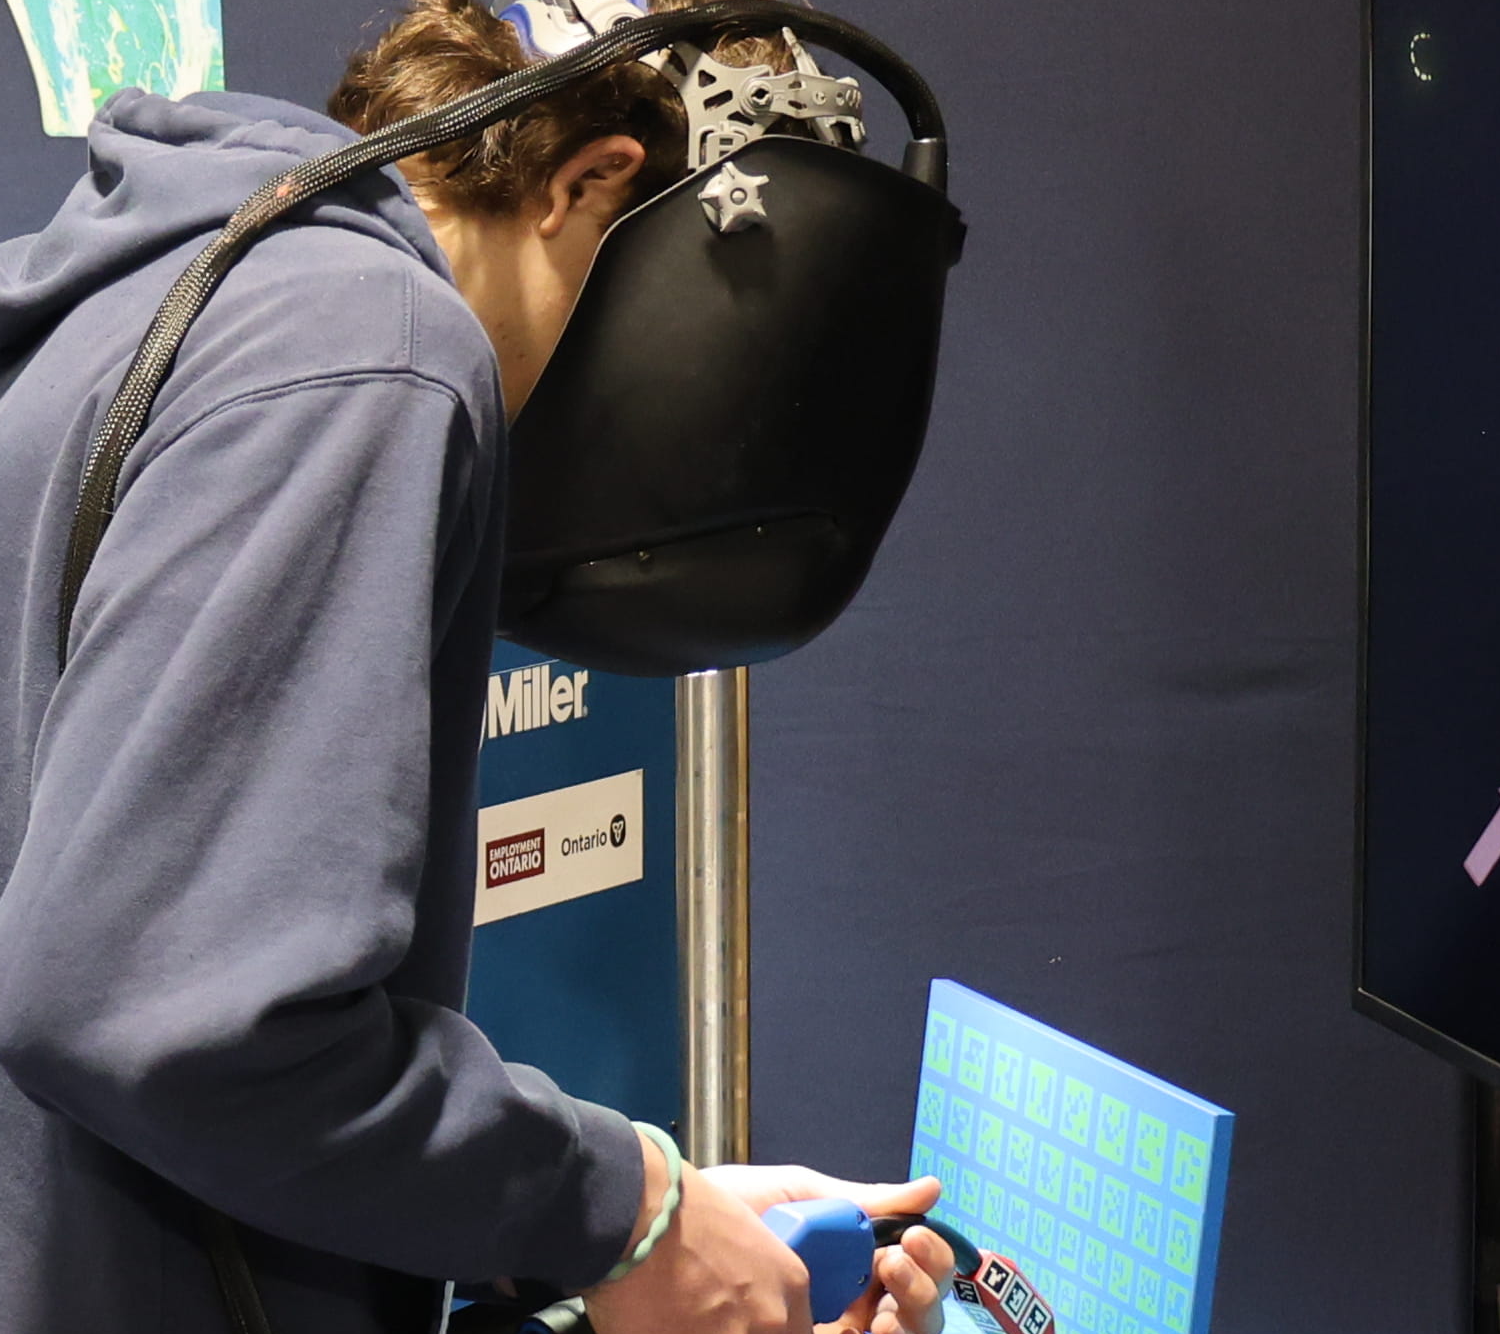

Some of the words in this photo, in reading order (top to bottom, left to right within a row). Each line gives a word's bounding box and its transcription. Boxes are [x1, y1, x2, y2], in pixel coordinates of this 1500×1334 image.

[488, 664, 588, 739] Miller
[490, 836, 541, 862] EMPLOYMENT
[561, 829, 608, 856] Ontario
[490, 852, 541, 880] ONTARIO
